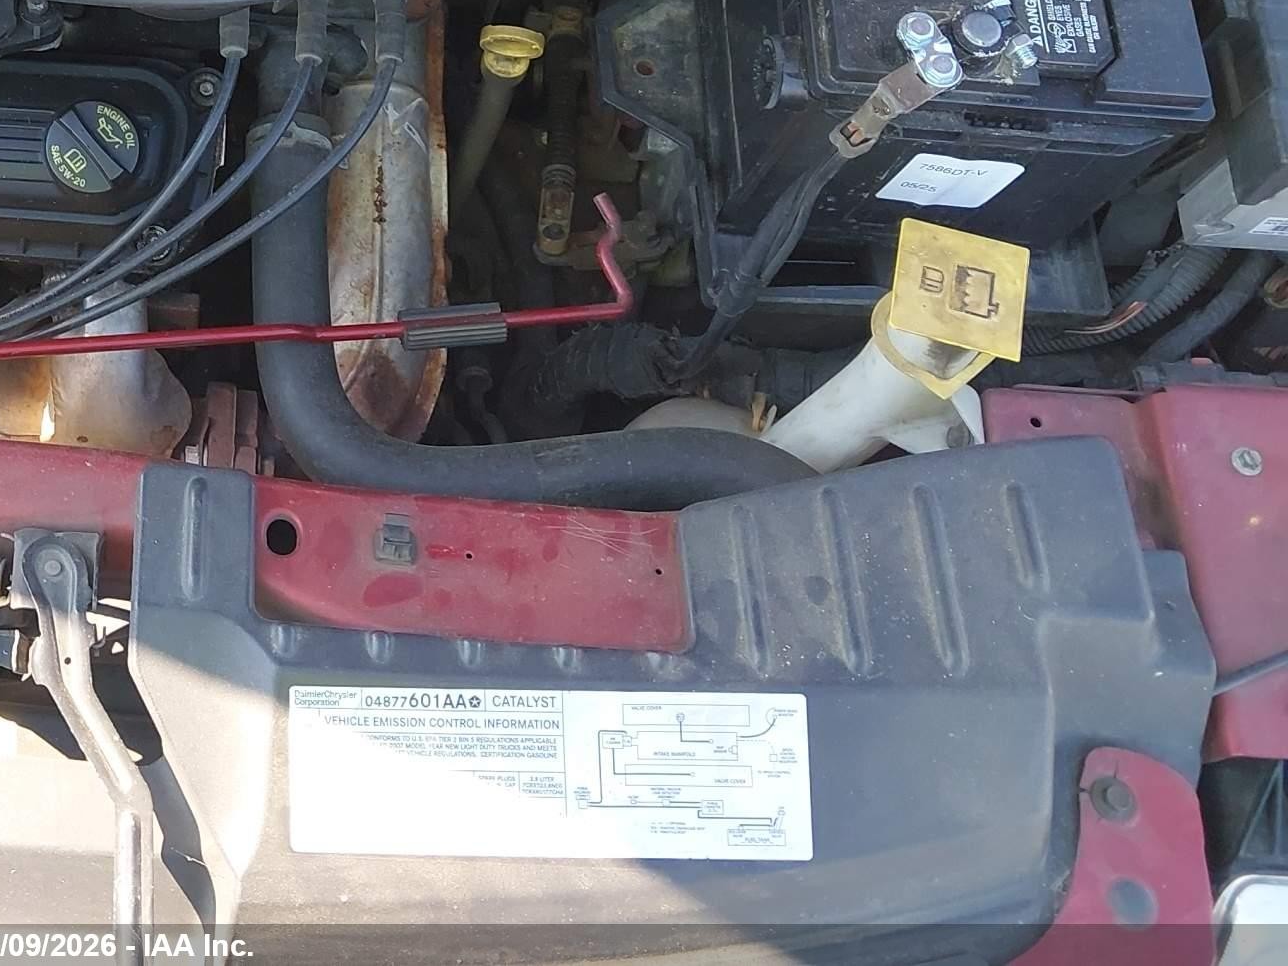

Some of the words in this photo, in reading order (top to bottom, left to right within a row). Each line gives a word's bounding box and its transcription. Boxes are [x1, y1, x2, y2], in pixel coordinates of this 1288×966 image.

[1074, 17, 1085, 37] GASES
[97, 105, 130, 131] ENGINE
[124, 132, 135, 150] OIL
[51, 145, 62, 166] SAE
[58, 165, 86, 188] 5W-20
[919, 163, 989, 177] 7586DT-V
[295, 690, 357, 699] DaimlerChrysler
[365, 693, 467, 709] 04877601AA
[295, 698, 340, 707] Corporation
[492, 696, 556, 708] CATALYST
[324, 716, 370, 726] VEHICLE
[373, 716, 426, 728] EMISSION
[429, 718, 481, 728] CONTROL
[484, 719, 560, 730] INFORMATION
